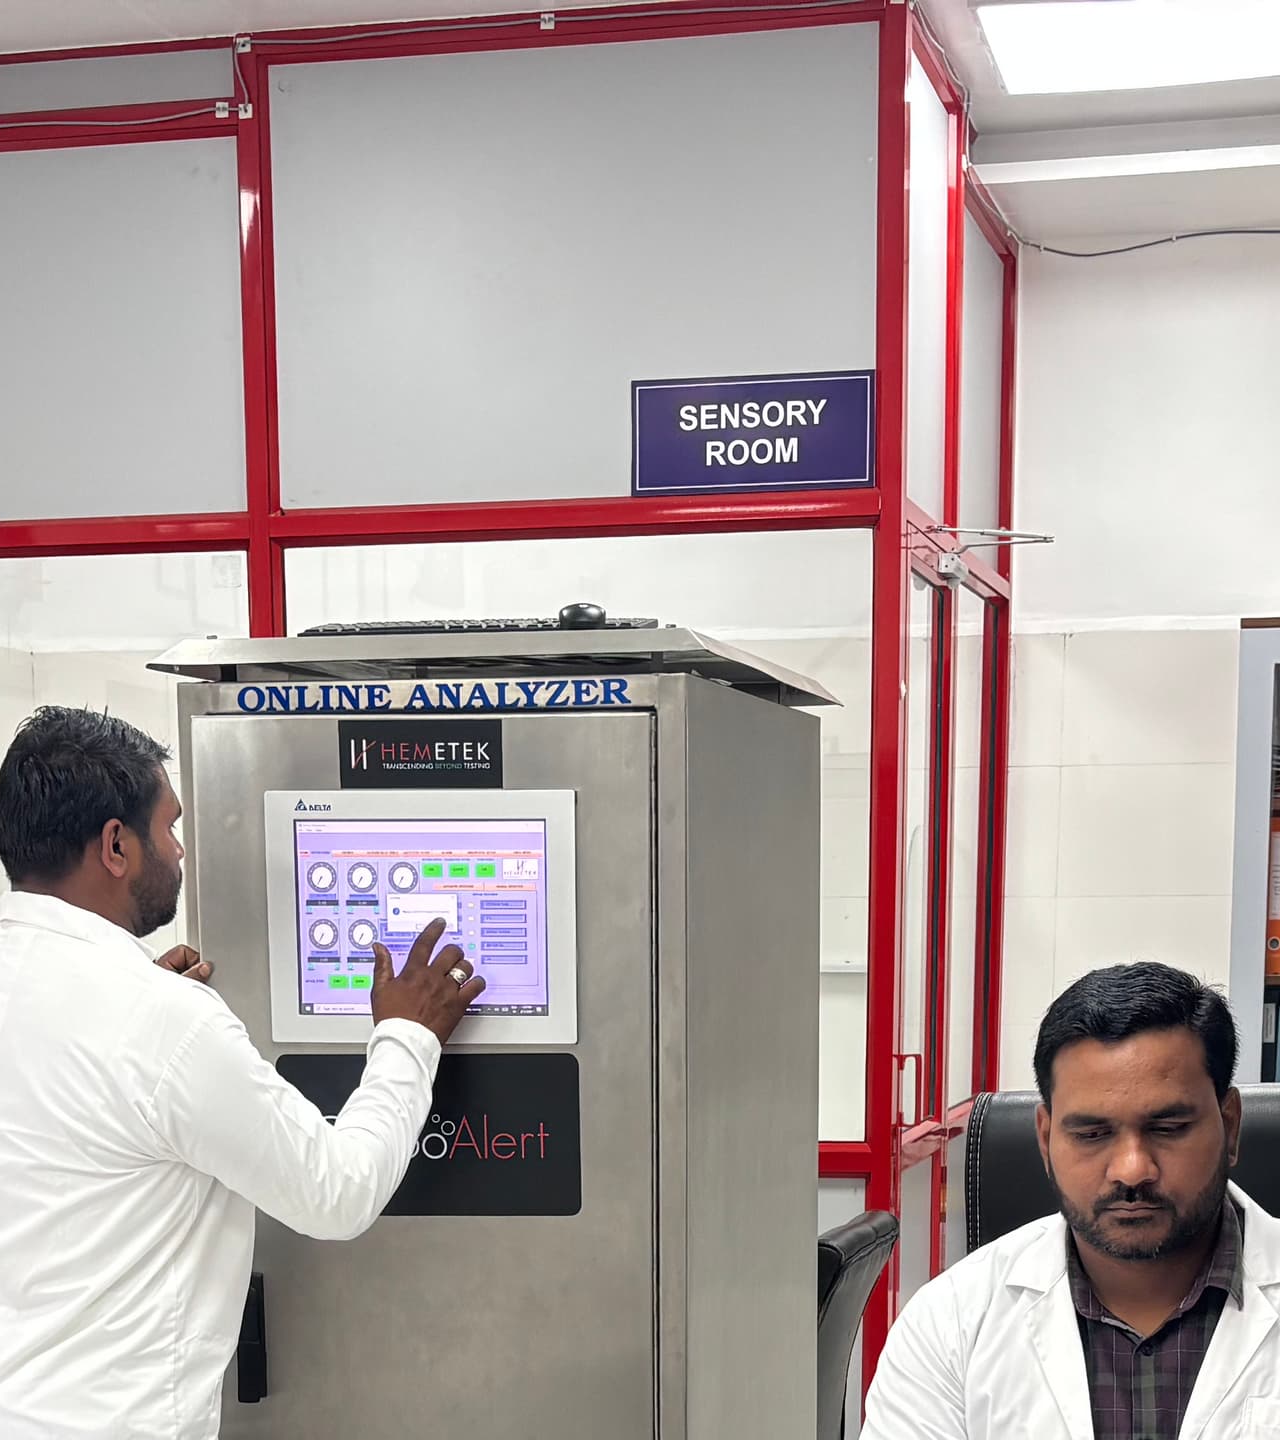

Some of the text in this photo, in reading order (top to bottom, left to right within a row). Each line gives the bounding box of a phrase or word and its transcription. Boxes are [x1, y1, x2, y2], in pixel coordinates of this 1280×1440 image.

[679, 399, 827, 431] SENSORY
[706, 437, 798, 466] ROOM
[237, 678, 632, 713] ONLINE ANALYZER
[381, 742, 490, 761] HEMETEK
